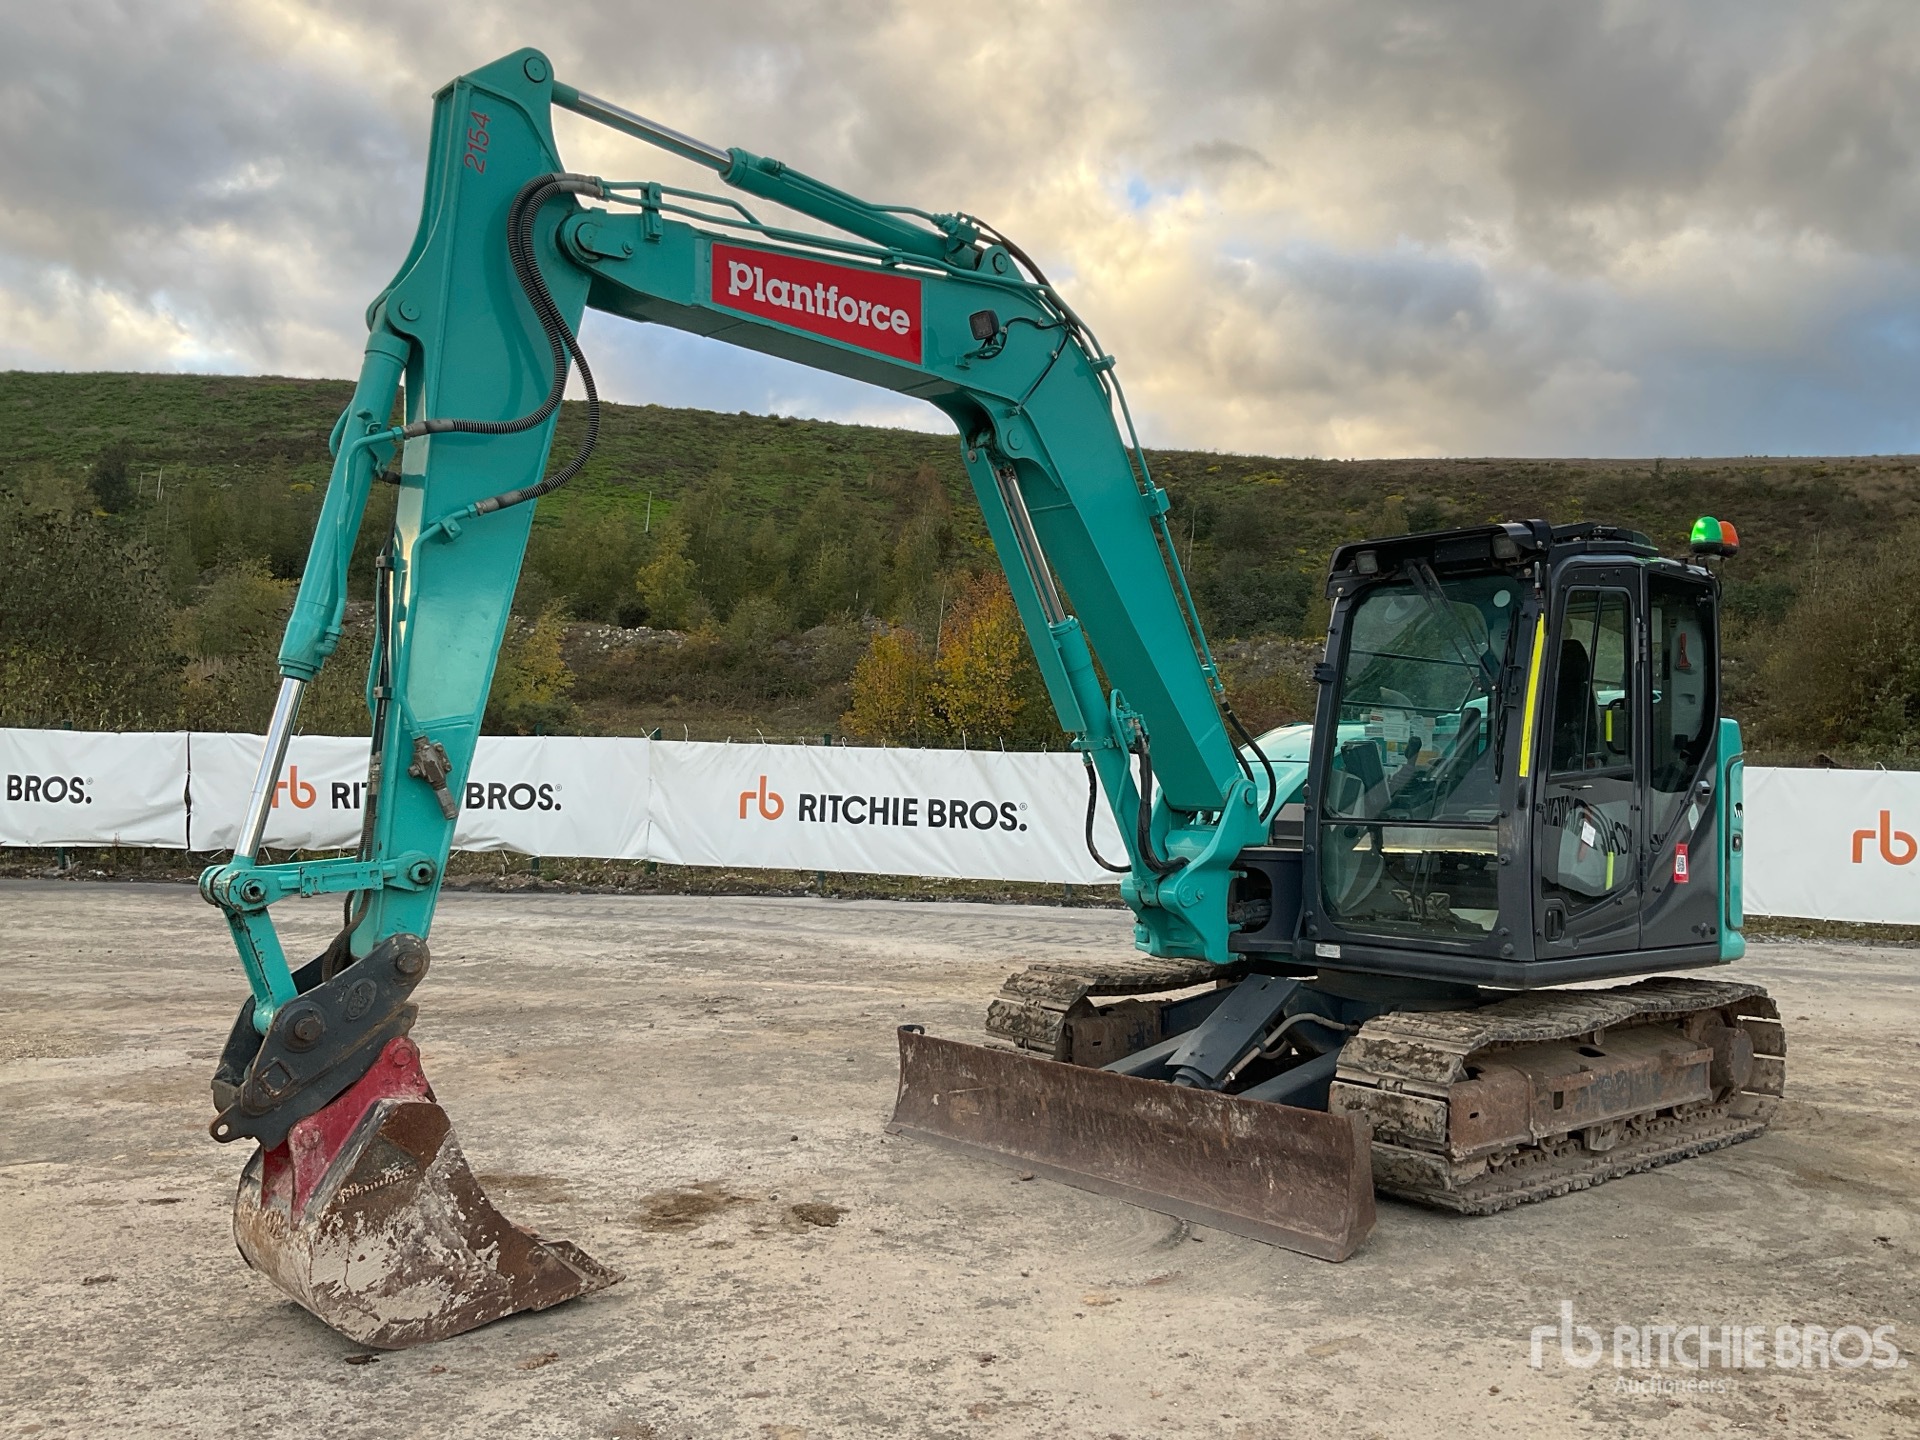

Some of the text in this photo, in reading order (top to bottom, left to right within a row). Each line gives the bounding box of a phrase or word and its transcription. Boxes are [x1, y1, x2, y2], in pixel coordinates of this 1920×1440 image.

[464, 111, 491, 174] 2154
[728, 260, 911, 335] plantforce
[738, 775, 785, 821] rb
[798, 793, 918, 827] RITCHIE
[1851, 809, 1919, 866] rb
